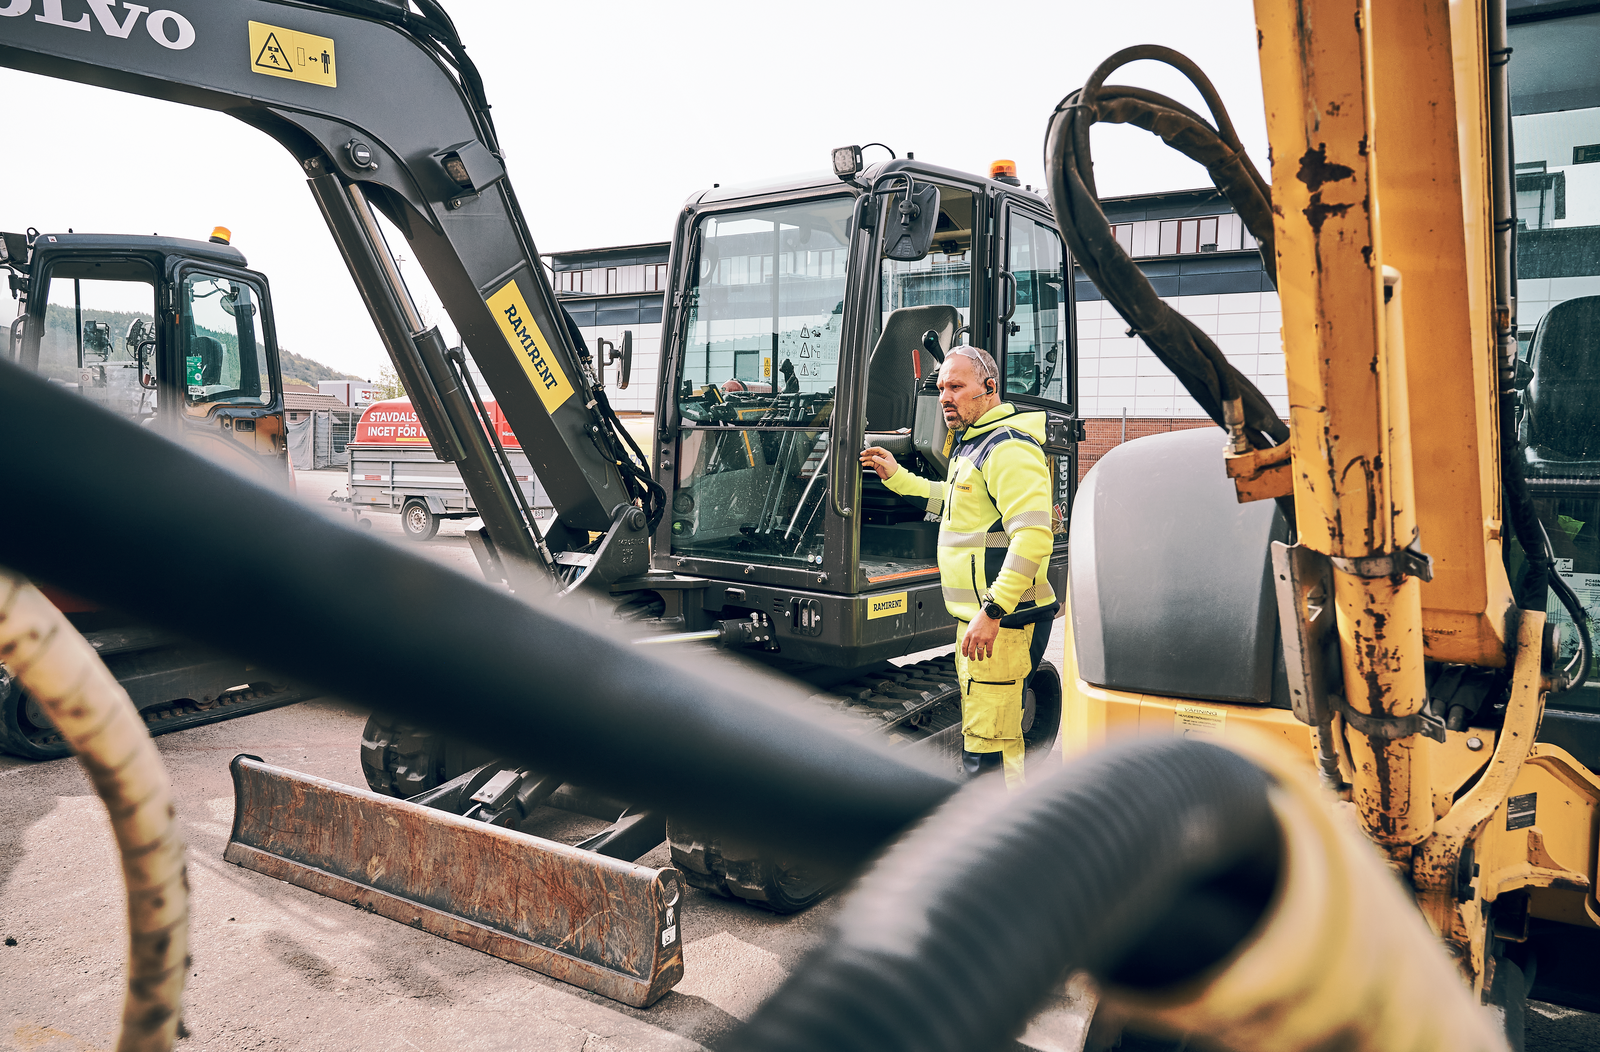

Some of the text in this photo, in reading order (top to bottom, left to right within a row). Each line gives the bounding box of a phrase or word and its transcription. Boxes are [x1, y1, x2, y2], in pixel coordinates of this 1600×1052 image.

[0, 0, 196, 50] LVO
[504, 304, 558, 390] RAMIRENT
[370, 412, 418, 422] STAVDALS
[367, 426, 396, 437] INGET
[397, 424, 417, 437] FÖR
[873, 599, 903, 612] RAMIRENT
